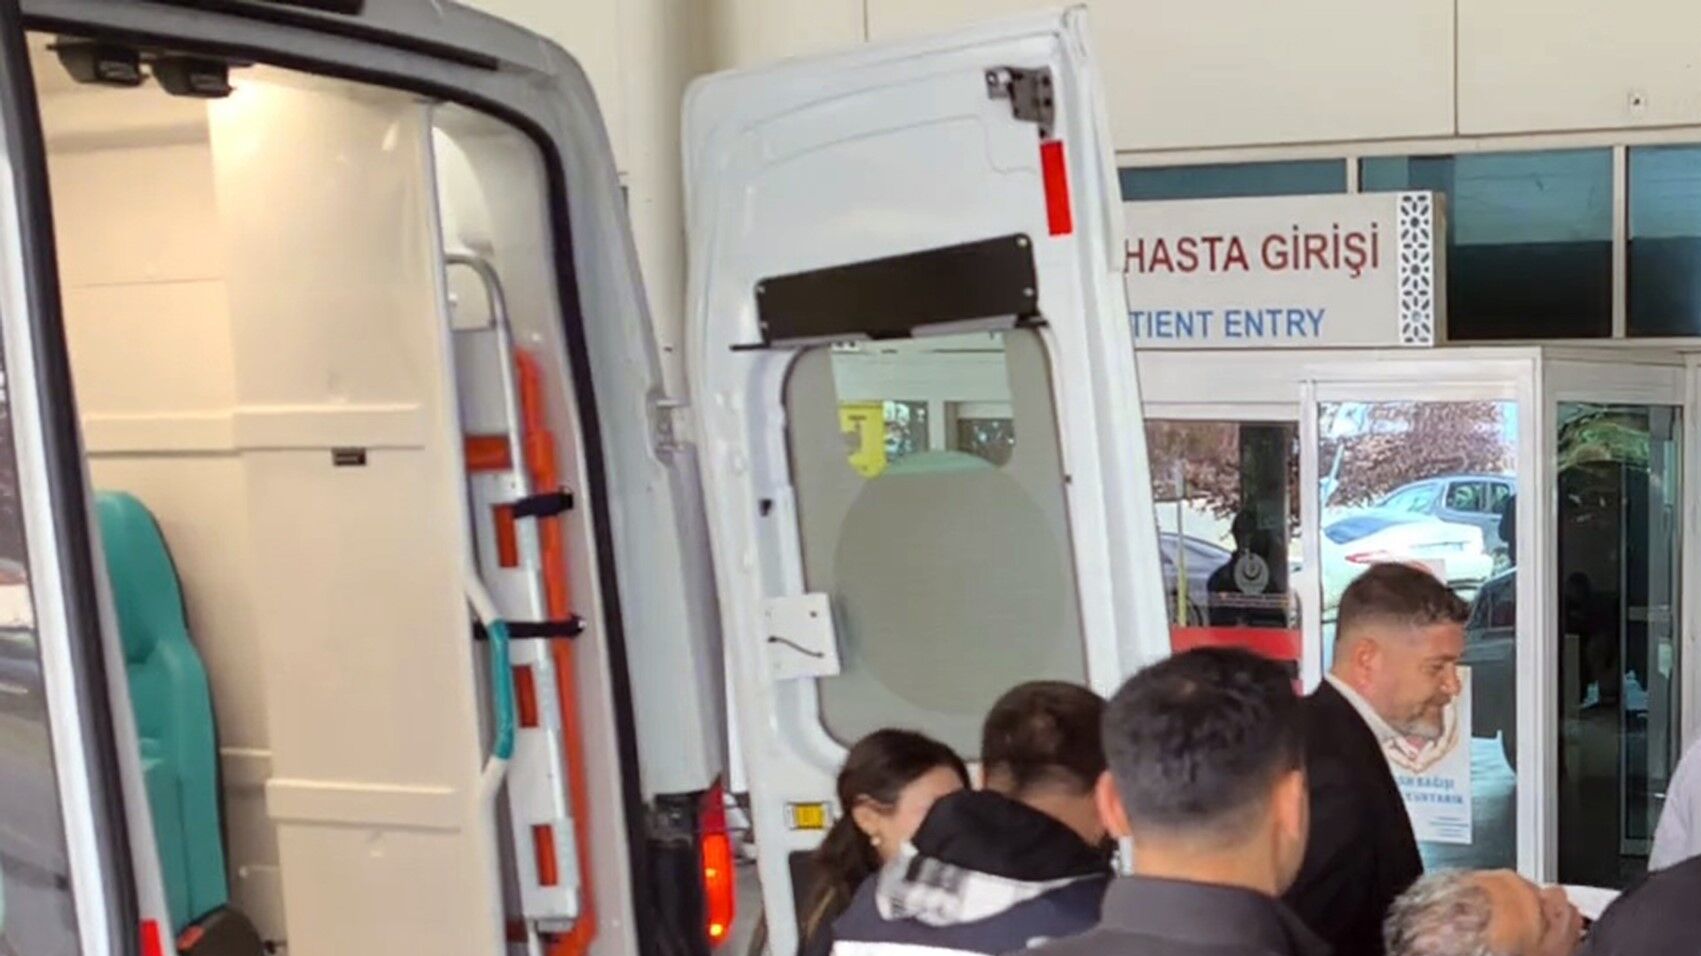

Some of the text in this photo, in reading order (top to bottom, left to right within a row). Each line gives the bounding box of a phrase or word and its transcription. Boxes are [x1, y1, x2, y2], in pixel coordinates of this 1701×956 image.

[1124, 223, 1379, 279] HASTA GİRİŞİ
[1128, 308, 1326, 338] TIENT ENTRY
